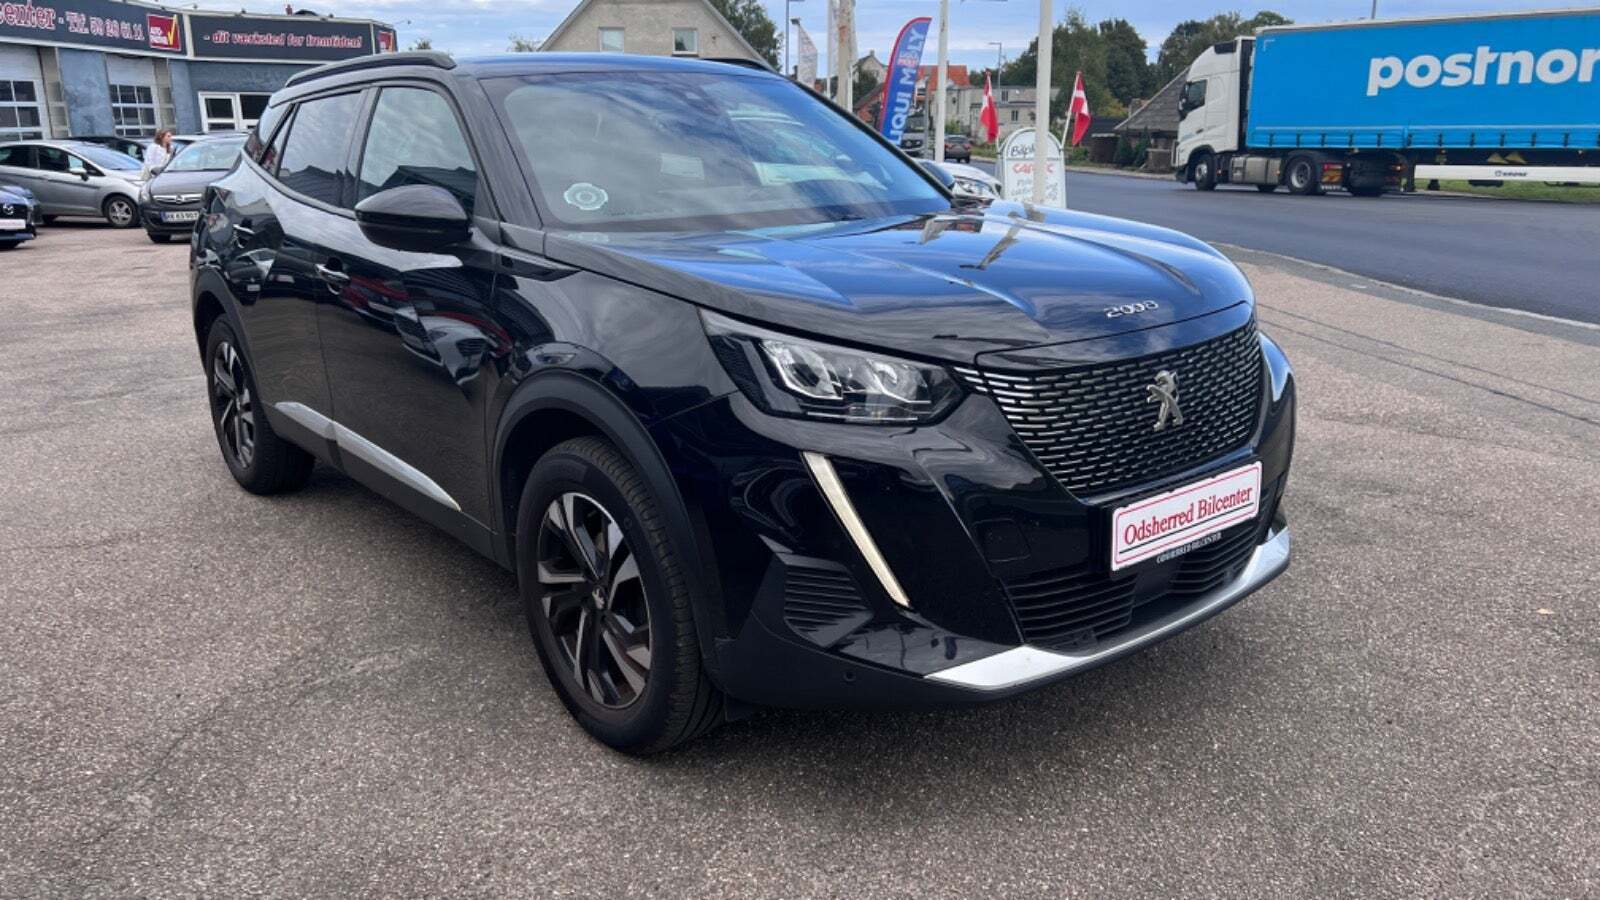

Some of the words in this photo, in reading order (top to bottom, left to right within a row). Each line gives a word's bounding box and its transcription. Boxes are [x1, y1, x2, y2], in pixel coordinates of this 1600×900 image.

[1103, 299, 1159, 319] 2008
[1123, 503, 1194, 545] Odsherred
[1197, 487, 1253, 519] Bilcenter
